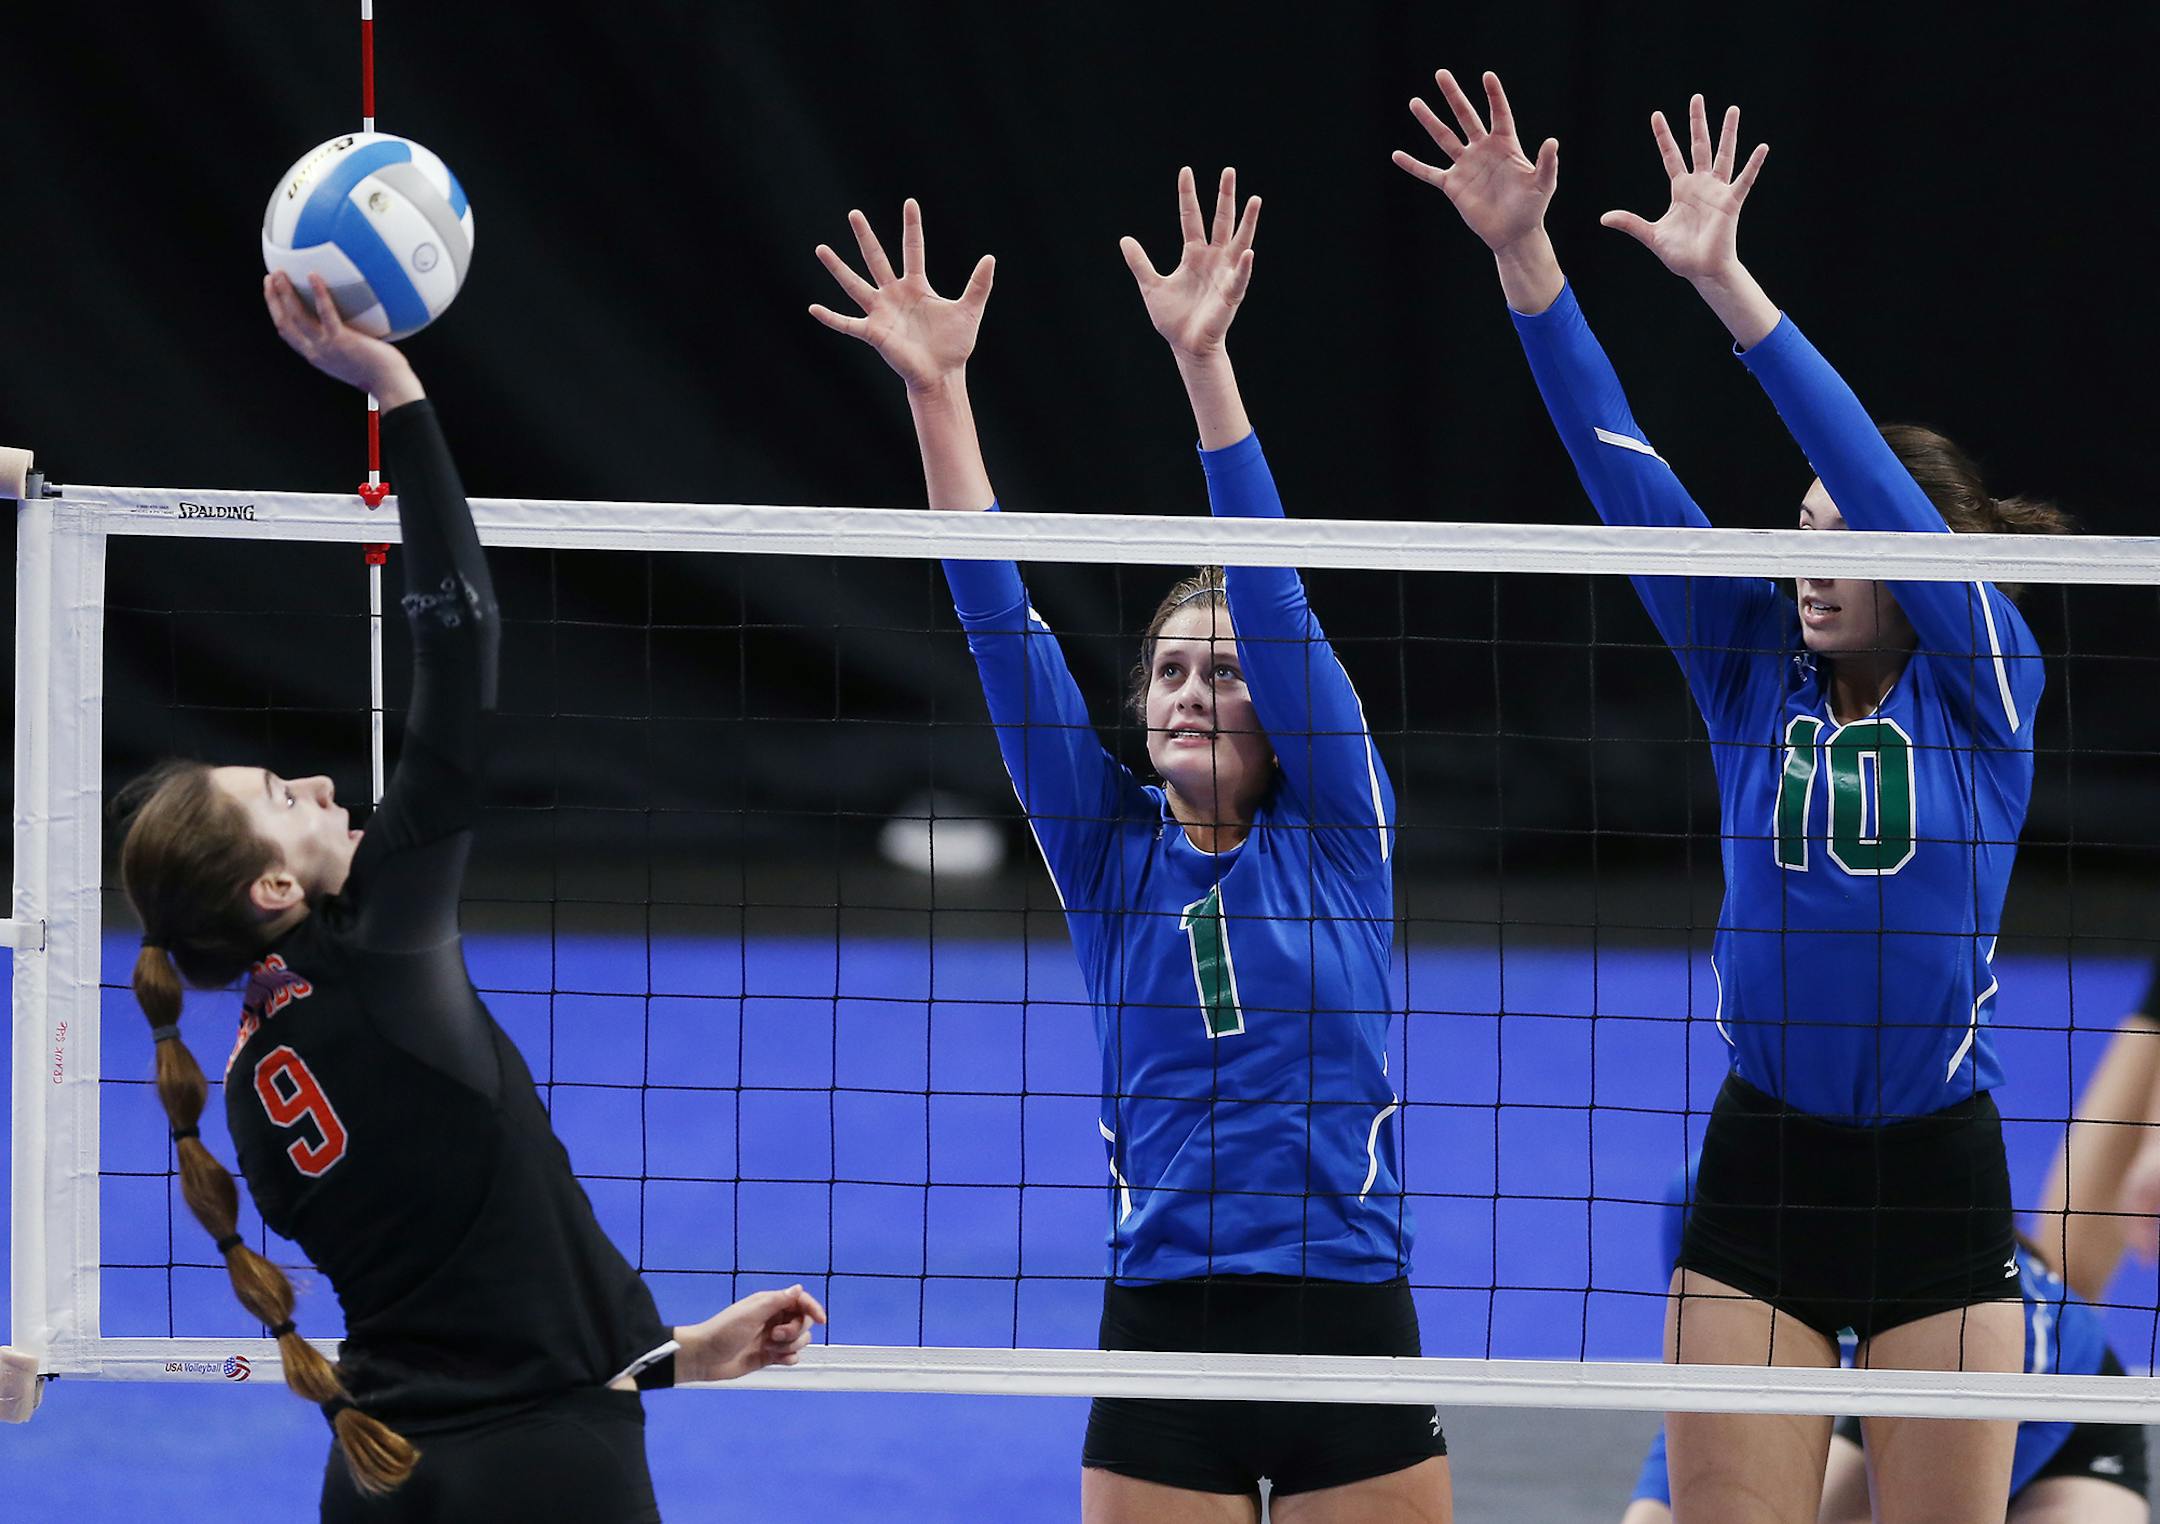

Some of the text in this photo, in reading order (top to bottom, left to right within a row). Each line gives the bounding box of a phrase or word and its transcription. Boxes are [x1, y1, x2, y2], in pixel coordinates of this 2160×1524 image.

[178, 502, 257, 521] SPALDING
[1773, 715, 1917, 876] 10
[1178, 883, 1246, 1039] 1
[254, 1044, 348, 1177] 9
[165, 1363, 221, 1375] USA Volleyball
